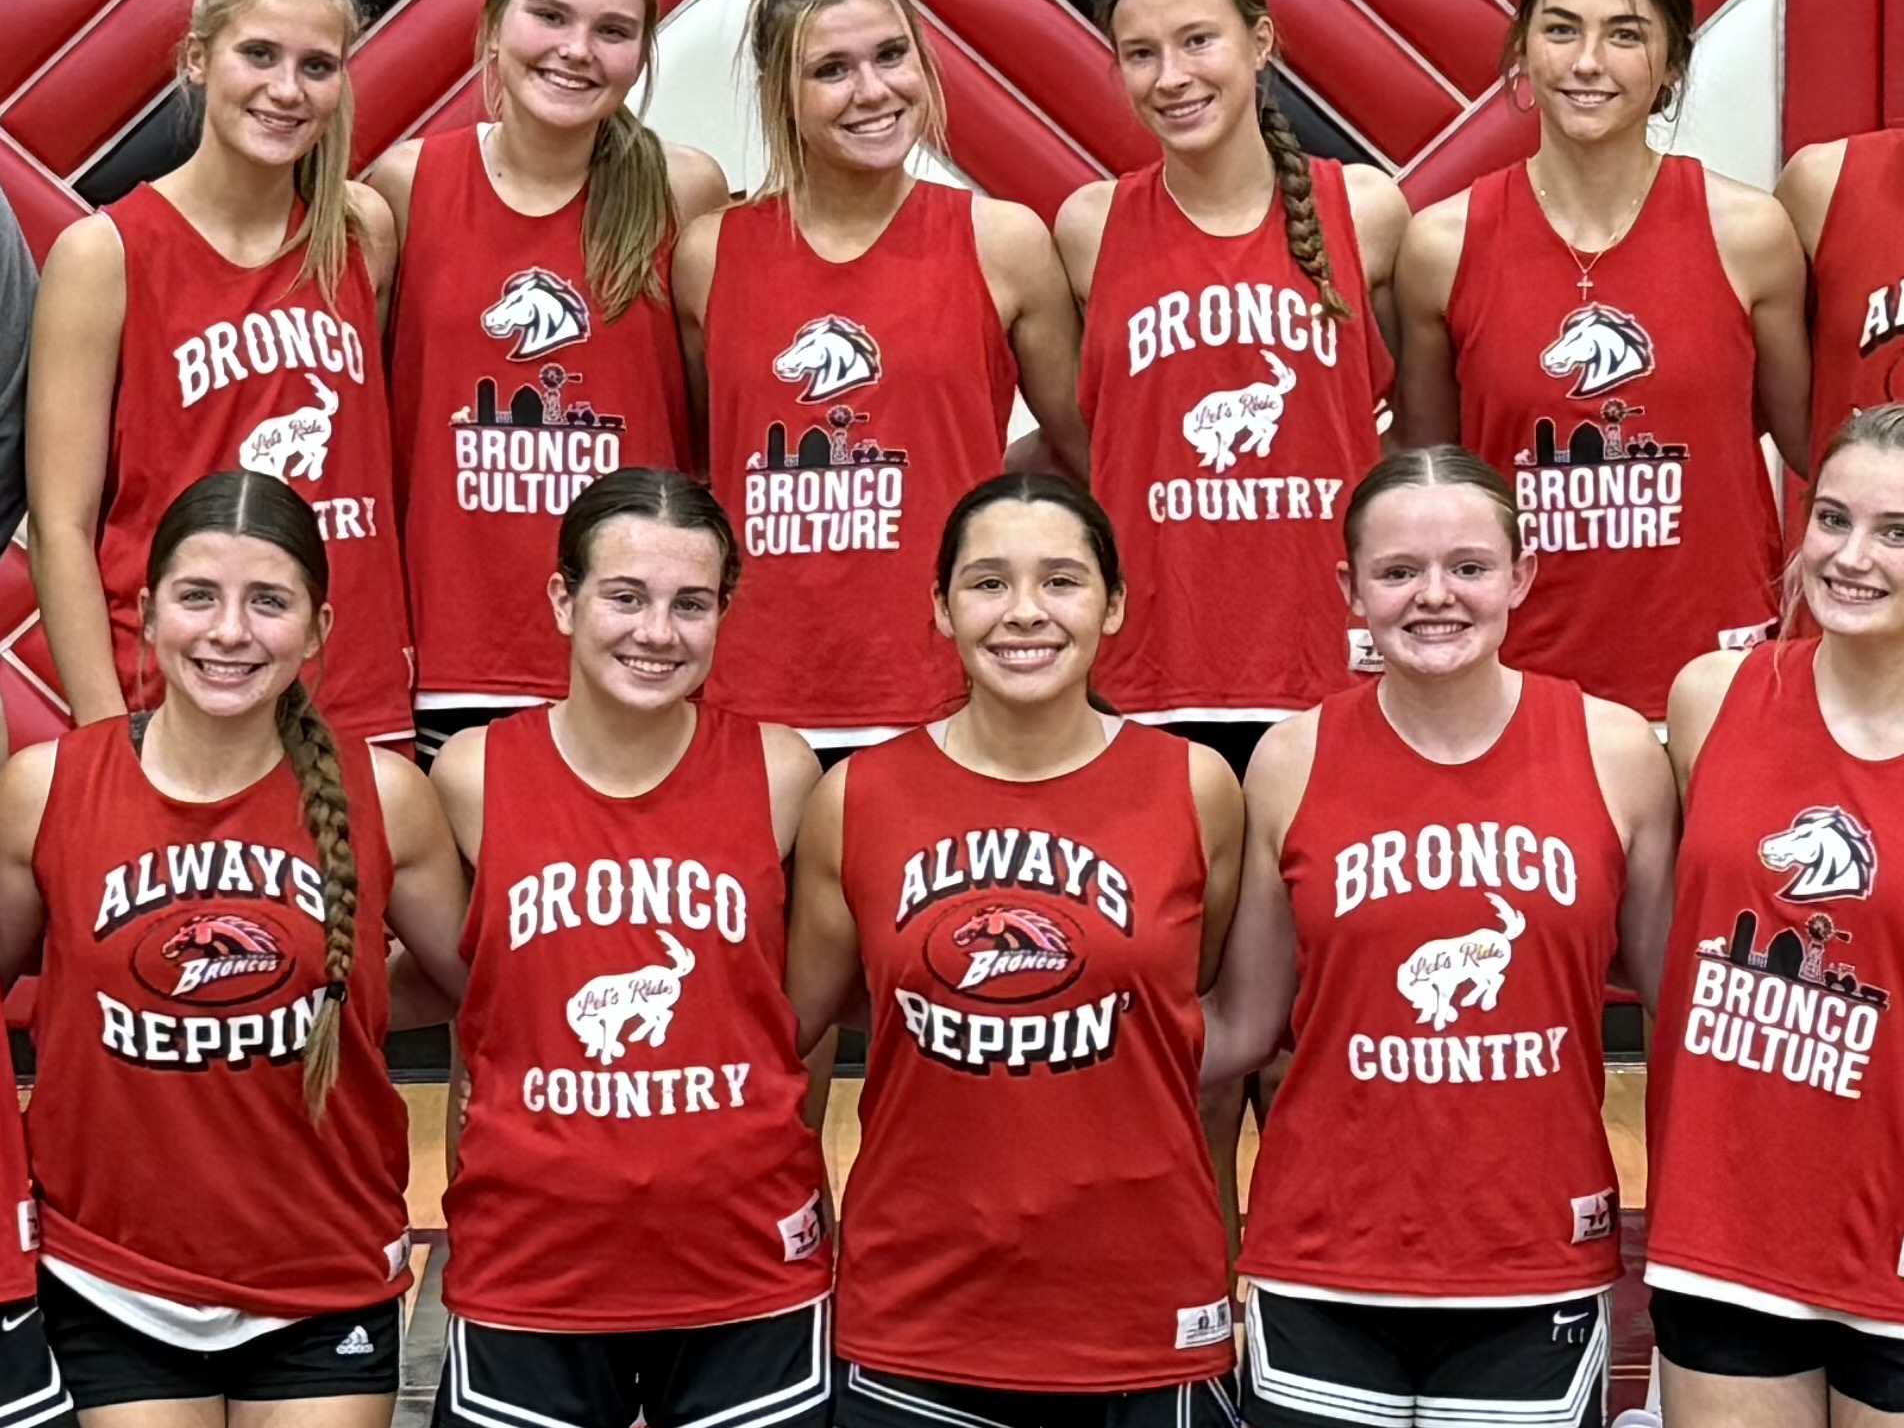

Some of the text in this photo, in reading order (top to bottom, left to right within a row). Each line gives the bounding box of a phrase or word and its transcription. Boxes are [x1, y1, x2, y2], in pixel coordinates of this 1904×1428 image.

[173, 307, 364, 409] BRONCO
[1128, 283, 1339, 376] BRONCO
[455, 429, 620, 473] BRONCO
[457, 469, 606, 515] CULTU
[746, 467, 902, 514] BRONCO
[1148, 477, 1342, 522] COUNTRY
[1516, 462, 1682, 511] BRONCO
[746, 509, 901, 555] CULTURE
[1517, 506, 1681, 552] CULTURE
[94, 839, 327, 929] ALWAYS
[897, 828, 1129, 927] ALWAYS
[1335, 821, 1577, 917] BRONCO
[508, 857, 746, 948] BRONCO
[1692, 960, 1880, 1050] BRONCO
[1349, 1026, 1567, 1084] COUNTRY
[1683, 1004, 1870, 1100] CULTURE
[523, 1062, 750, 1120] COUNTRY
